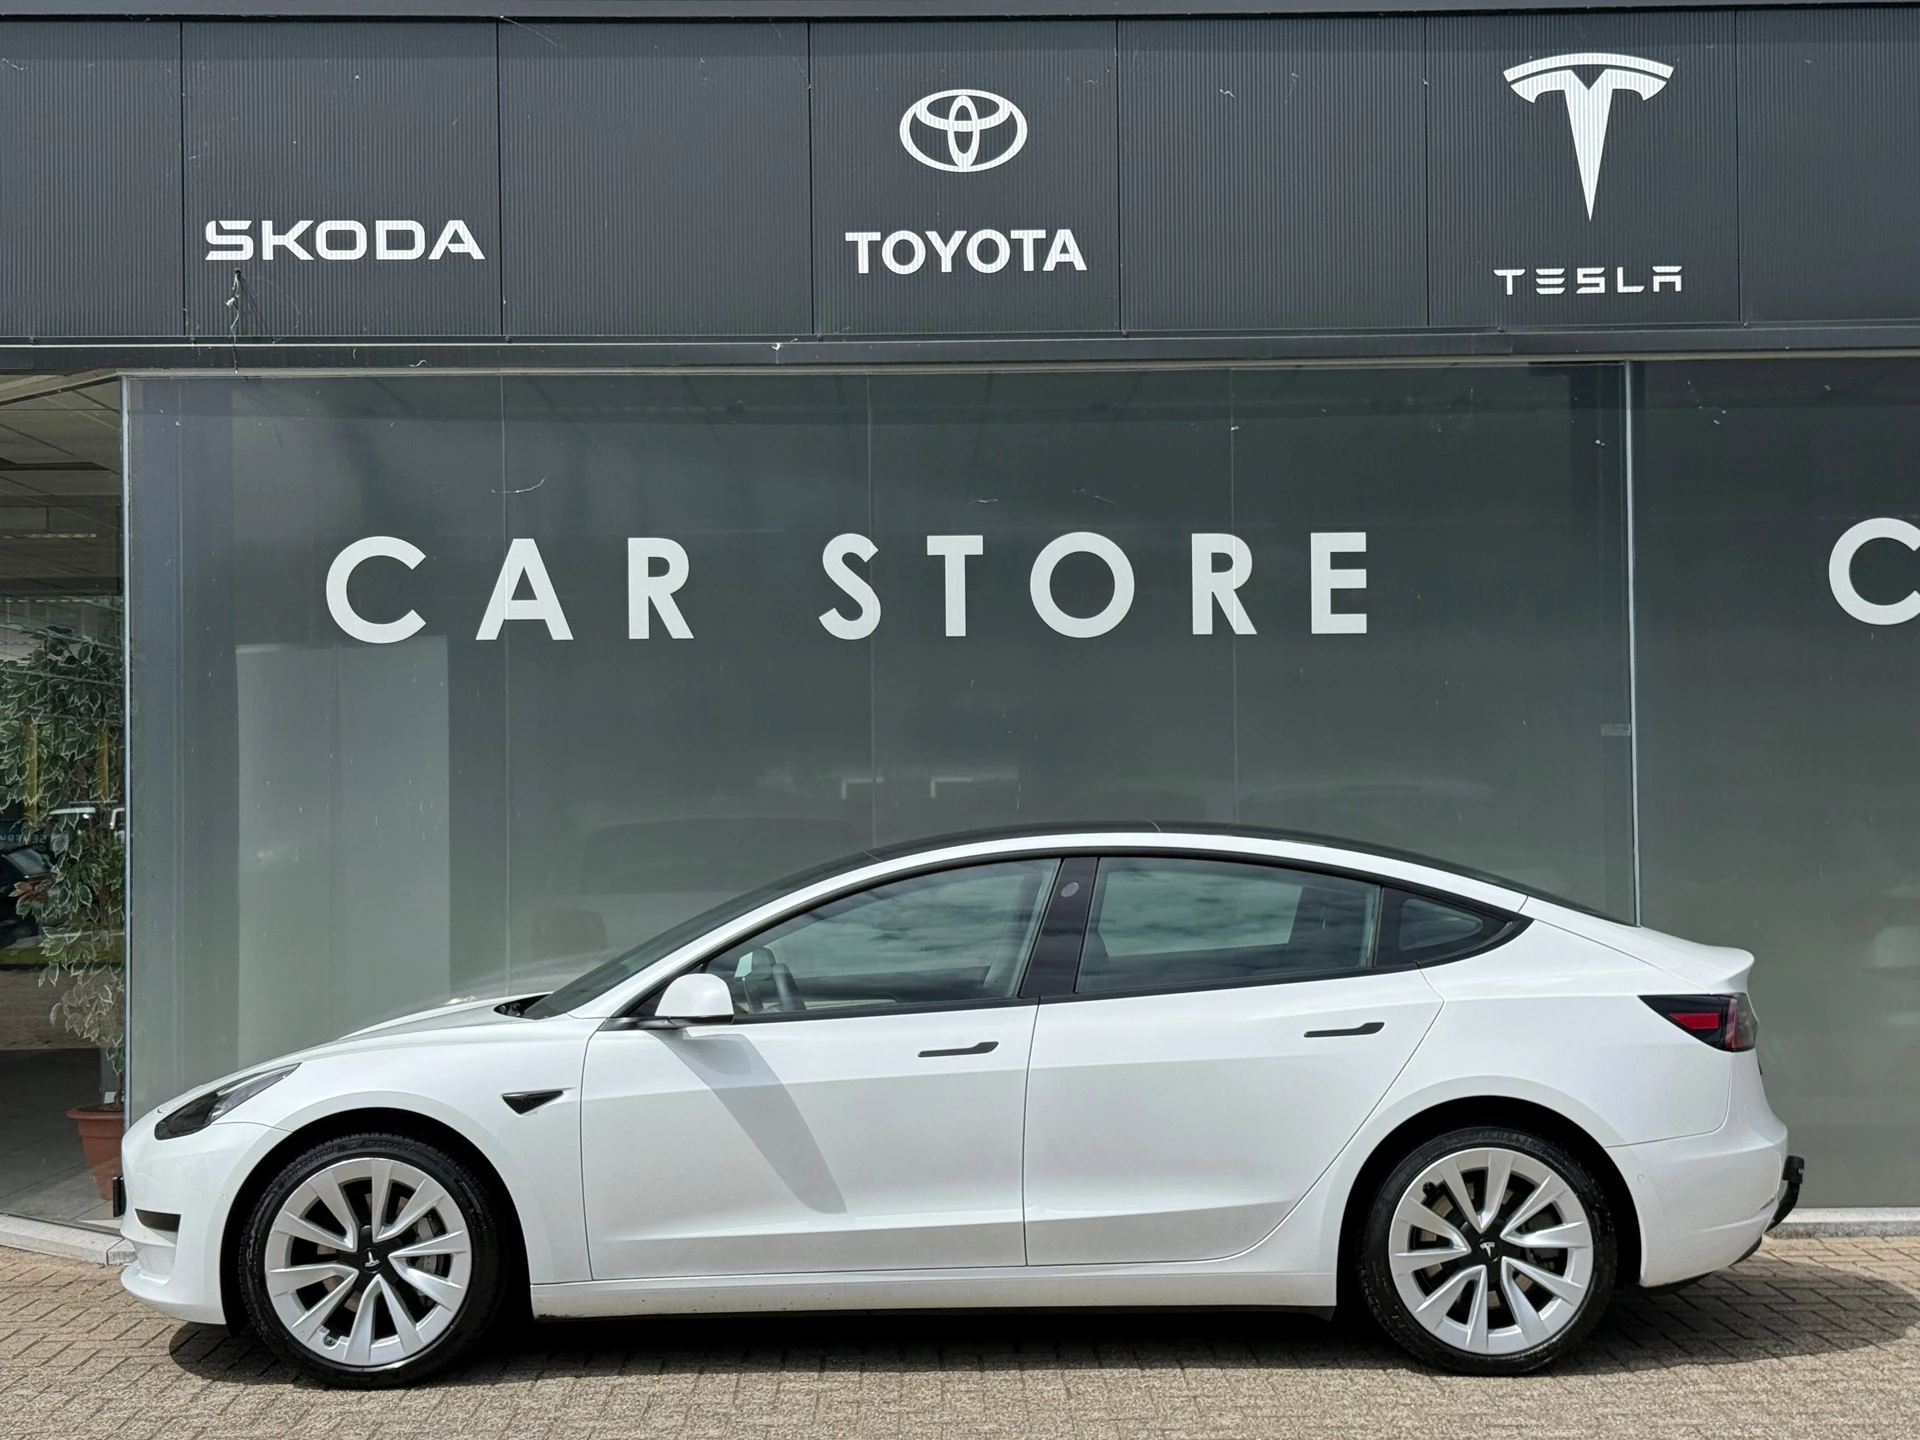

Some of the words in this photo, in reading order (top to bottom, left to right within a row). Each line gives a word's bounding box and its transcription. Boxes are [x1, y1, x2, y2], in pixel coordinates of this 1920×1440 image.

[845, 228, 1088, 275] TOYOTA
[1493, 265, 1684, 296] TESLA
[325, 535, 695, 644] CAR
[818, 531, 1367, 640] STORE
[1828, 517, 1920, 625] C
